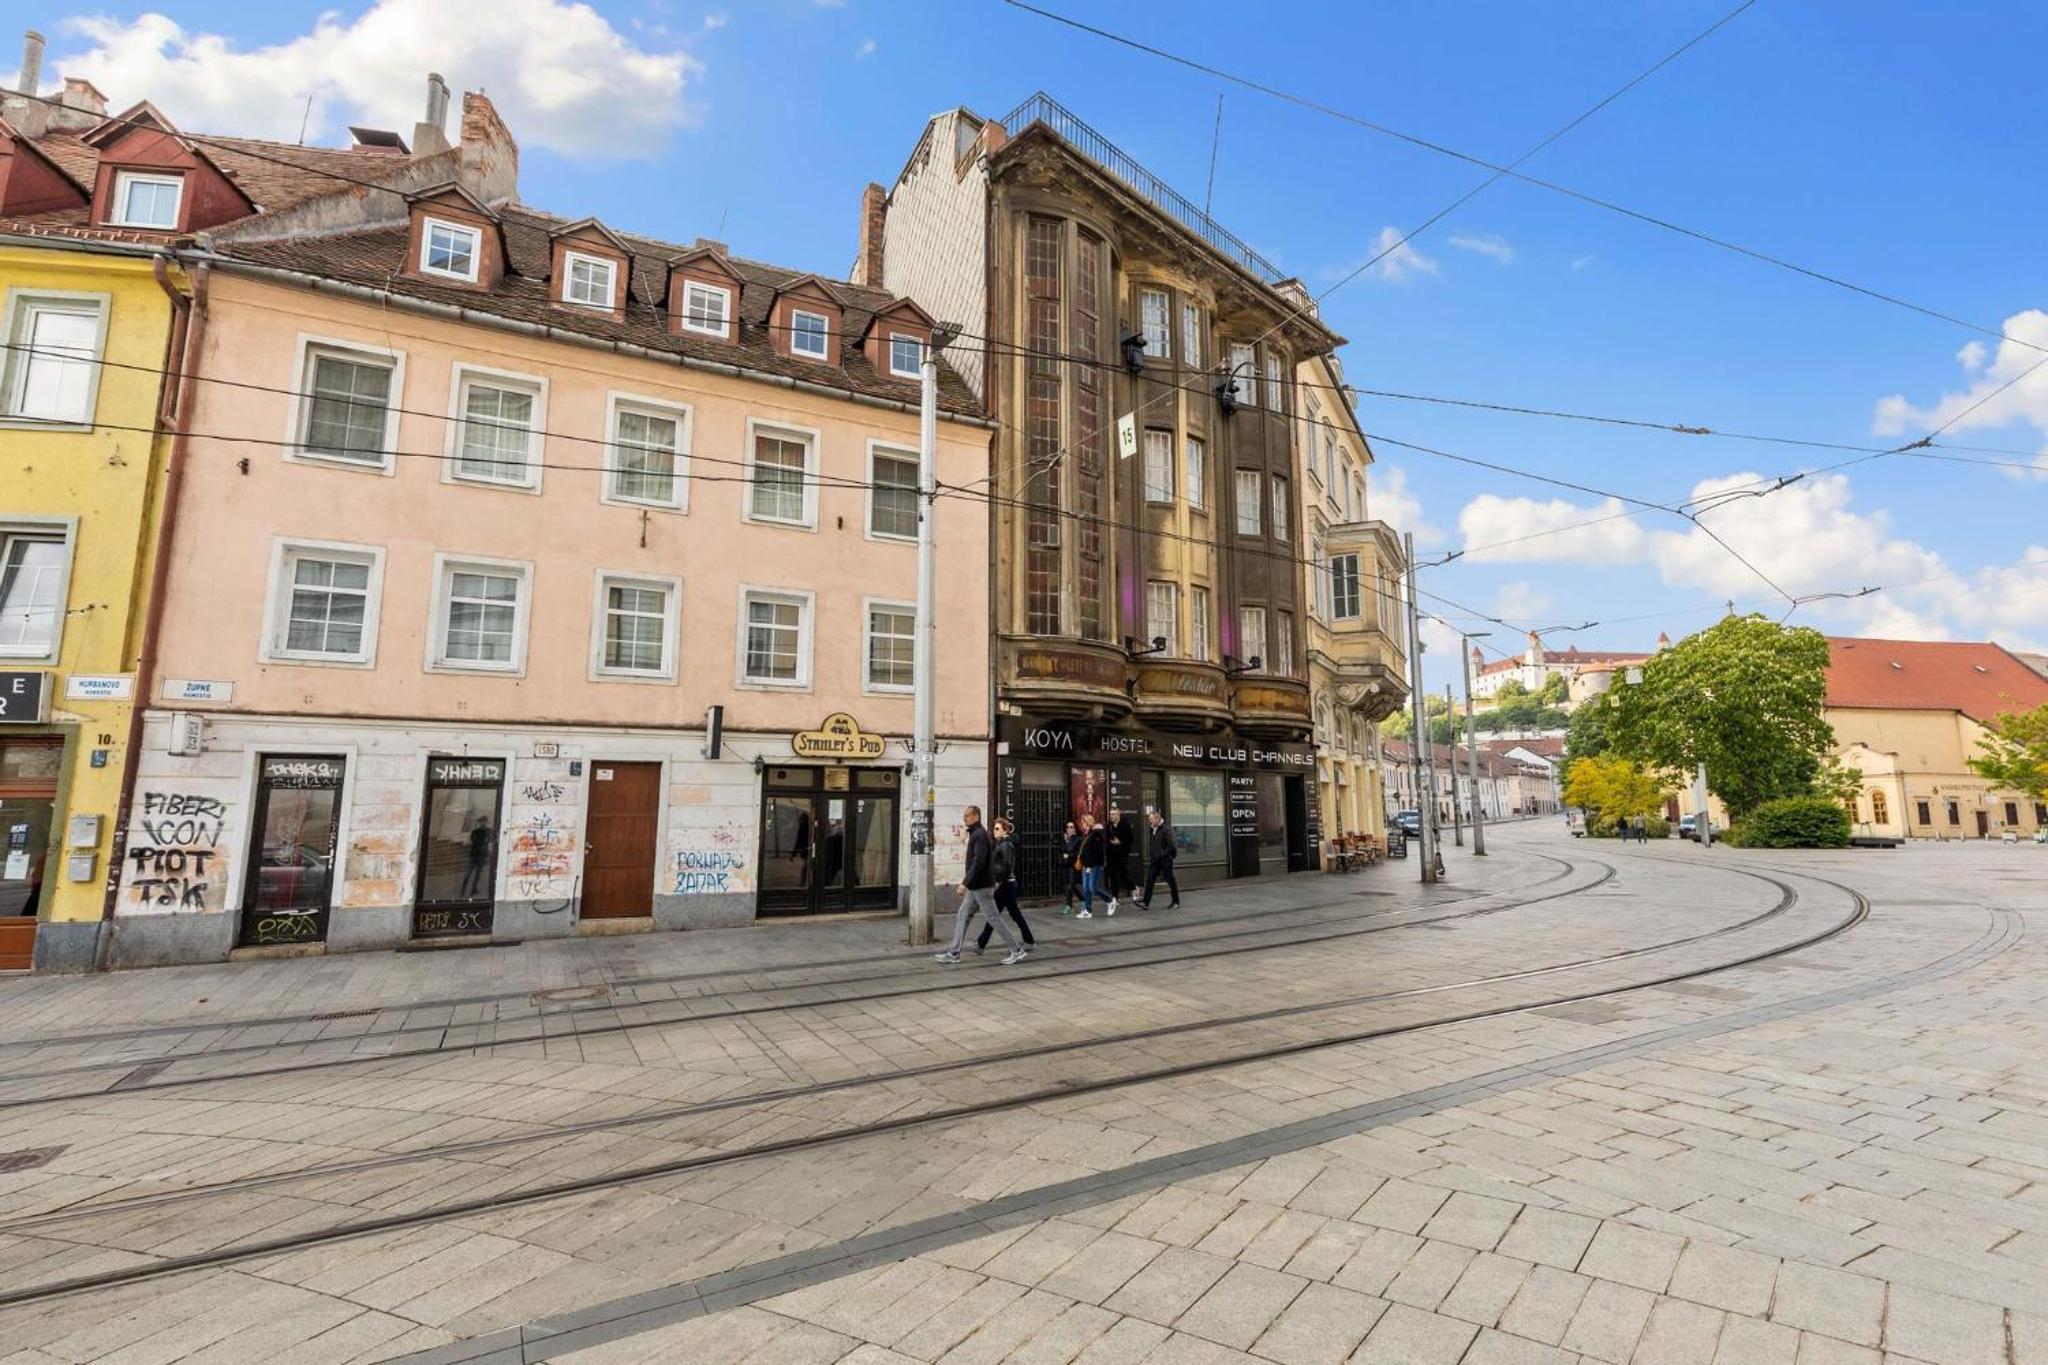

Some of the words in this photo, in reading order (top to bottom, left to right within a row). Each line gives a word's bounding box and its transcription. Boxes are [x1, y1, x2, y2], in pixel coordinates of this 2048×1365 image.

[1122, 427, 1133, 446] 15
[1024, 728, 1073, 750] KOYA
[1101, 737, 1151, 754] HOSTEL
[1173, 744, 1203, 758] NEW
[1209, 747, 1246, 761] CLUB
[1252, 750, 1314, 765] CHANNELS
[1231, 777, 1254, 786] PARTY
[1232, 808, 1256, 819] OPEN
